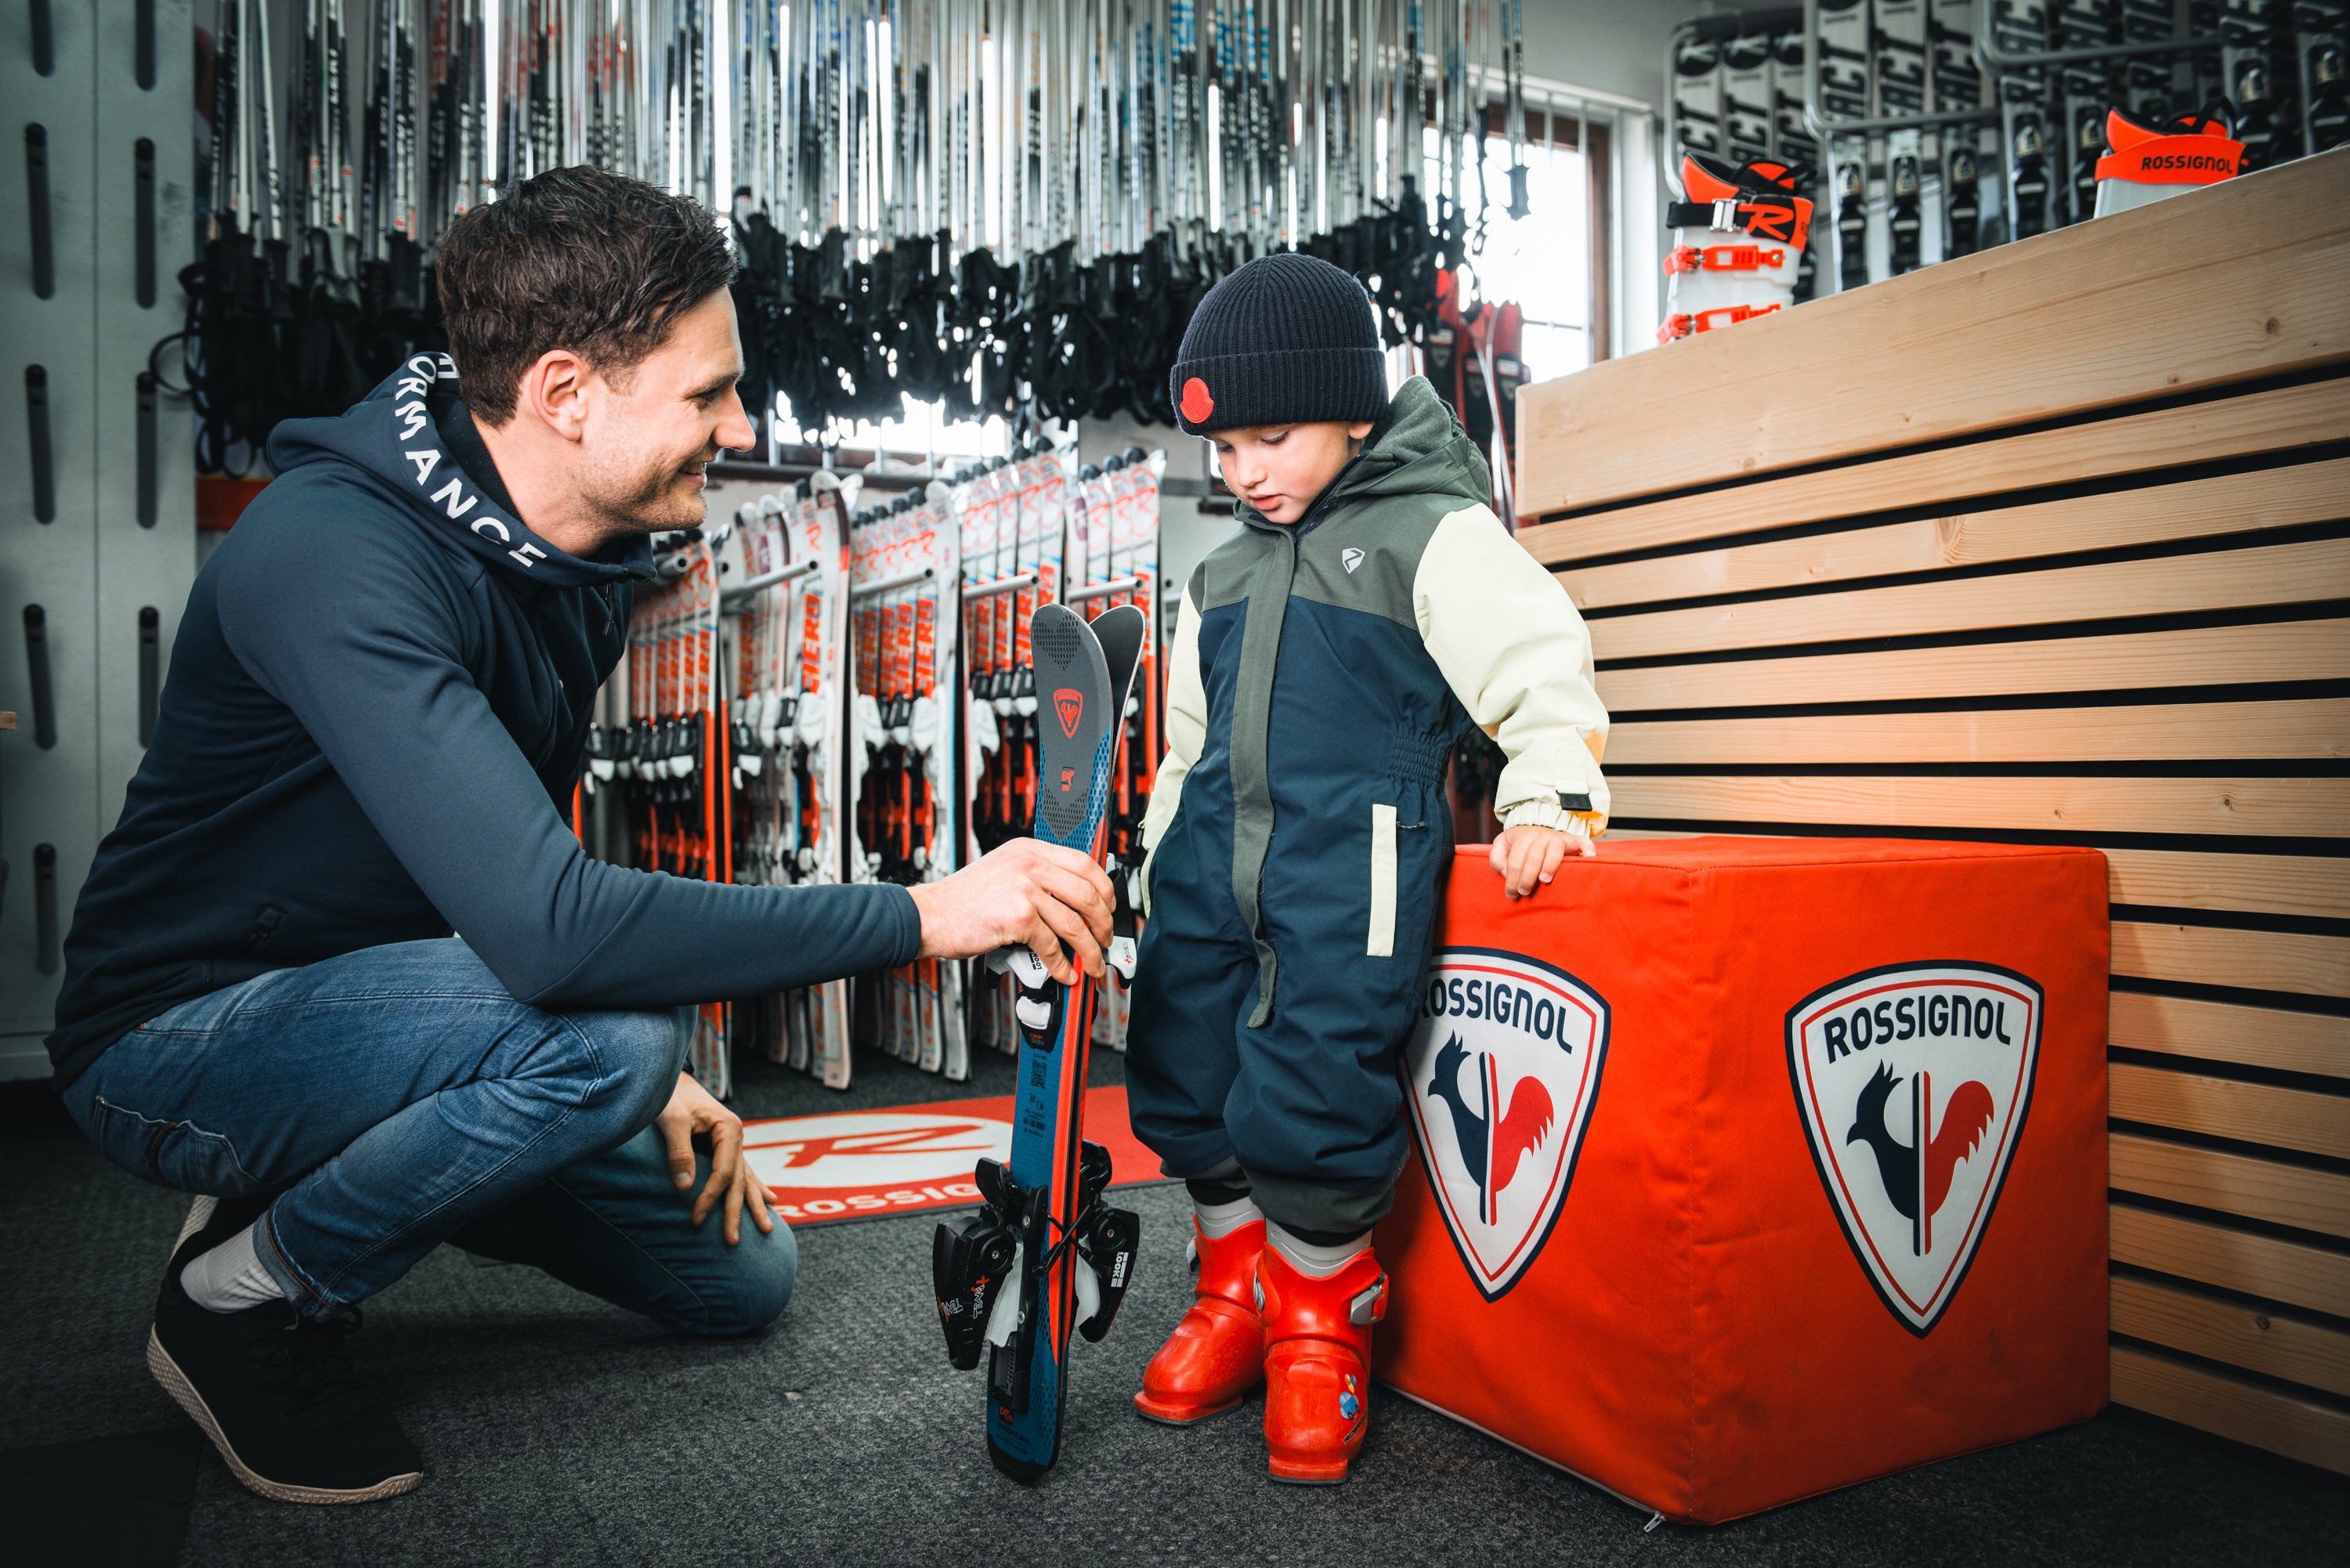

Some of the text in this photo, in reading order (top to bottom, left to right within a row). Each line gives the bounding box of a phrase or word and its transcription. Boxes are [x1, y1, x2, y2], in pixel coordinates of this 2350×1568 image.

[2141, 155, 2232, 174] ROSSIGNOL
[394, 352, 548, 568] FORMANCE
[1032, 950, 1043, 970] LOOK
[1825, 995, 2012, 1064] ROSSIGNOL
[774, 1183, 981, 1219] ROSSIG
[1112, 1252, 1124, 1278] LOOK
